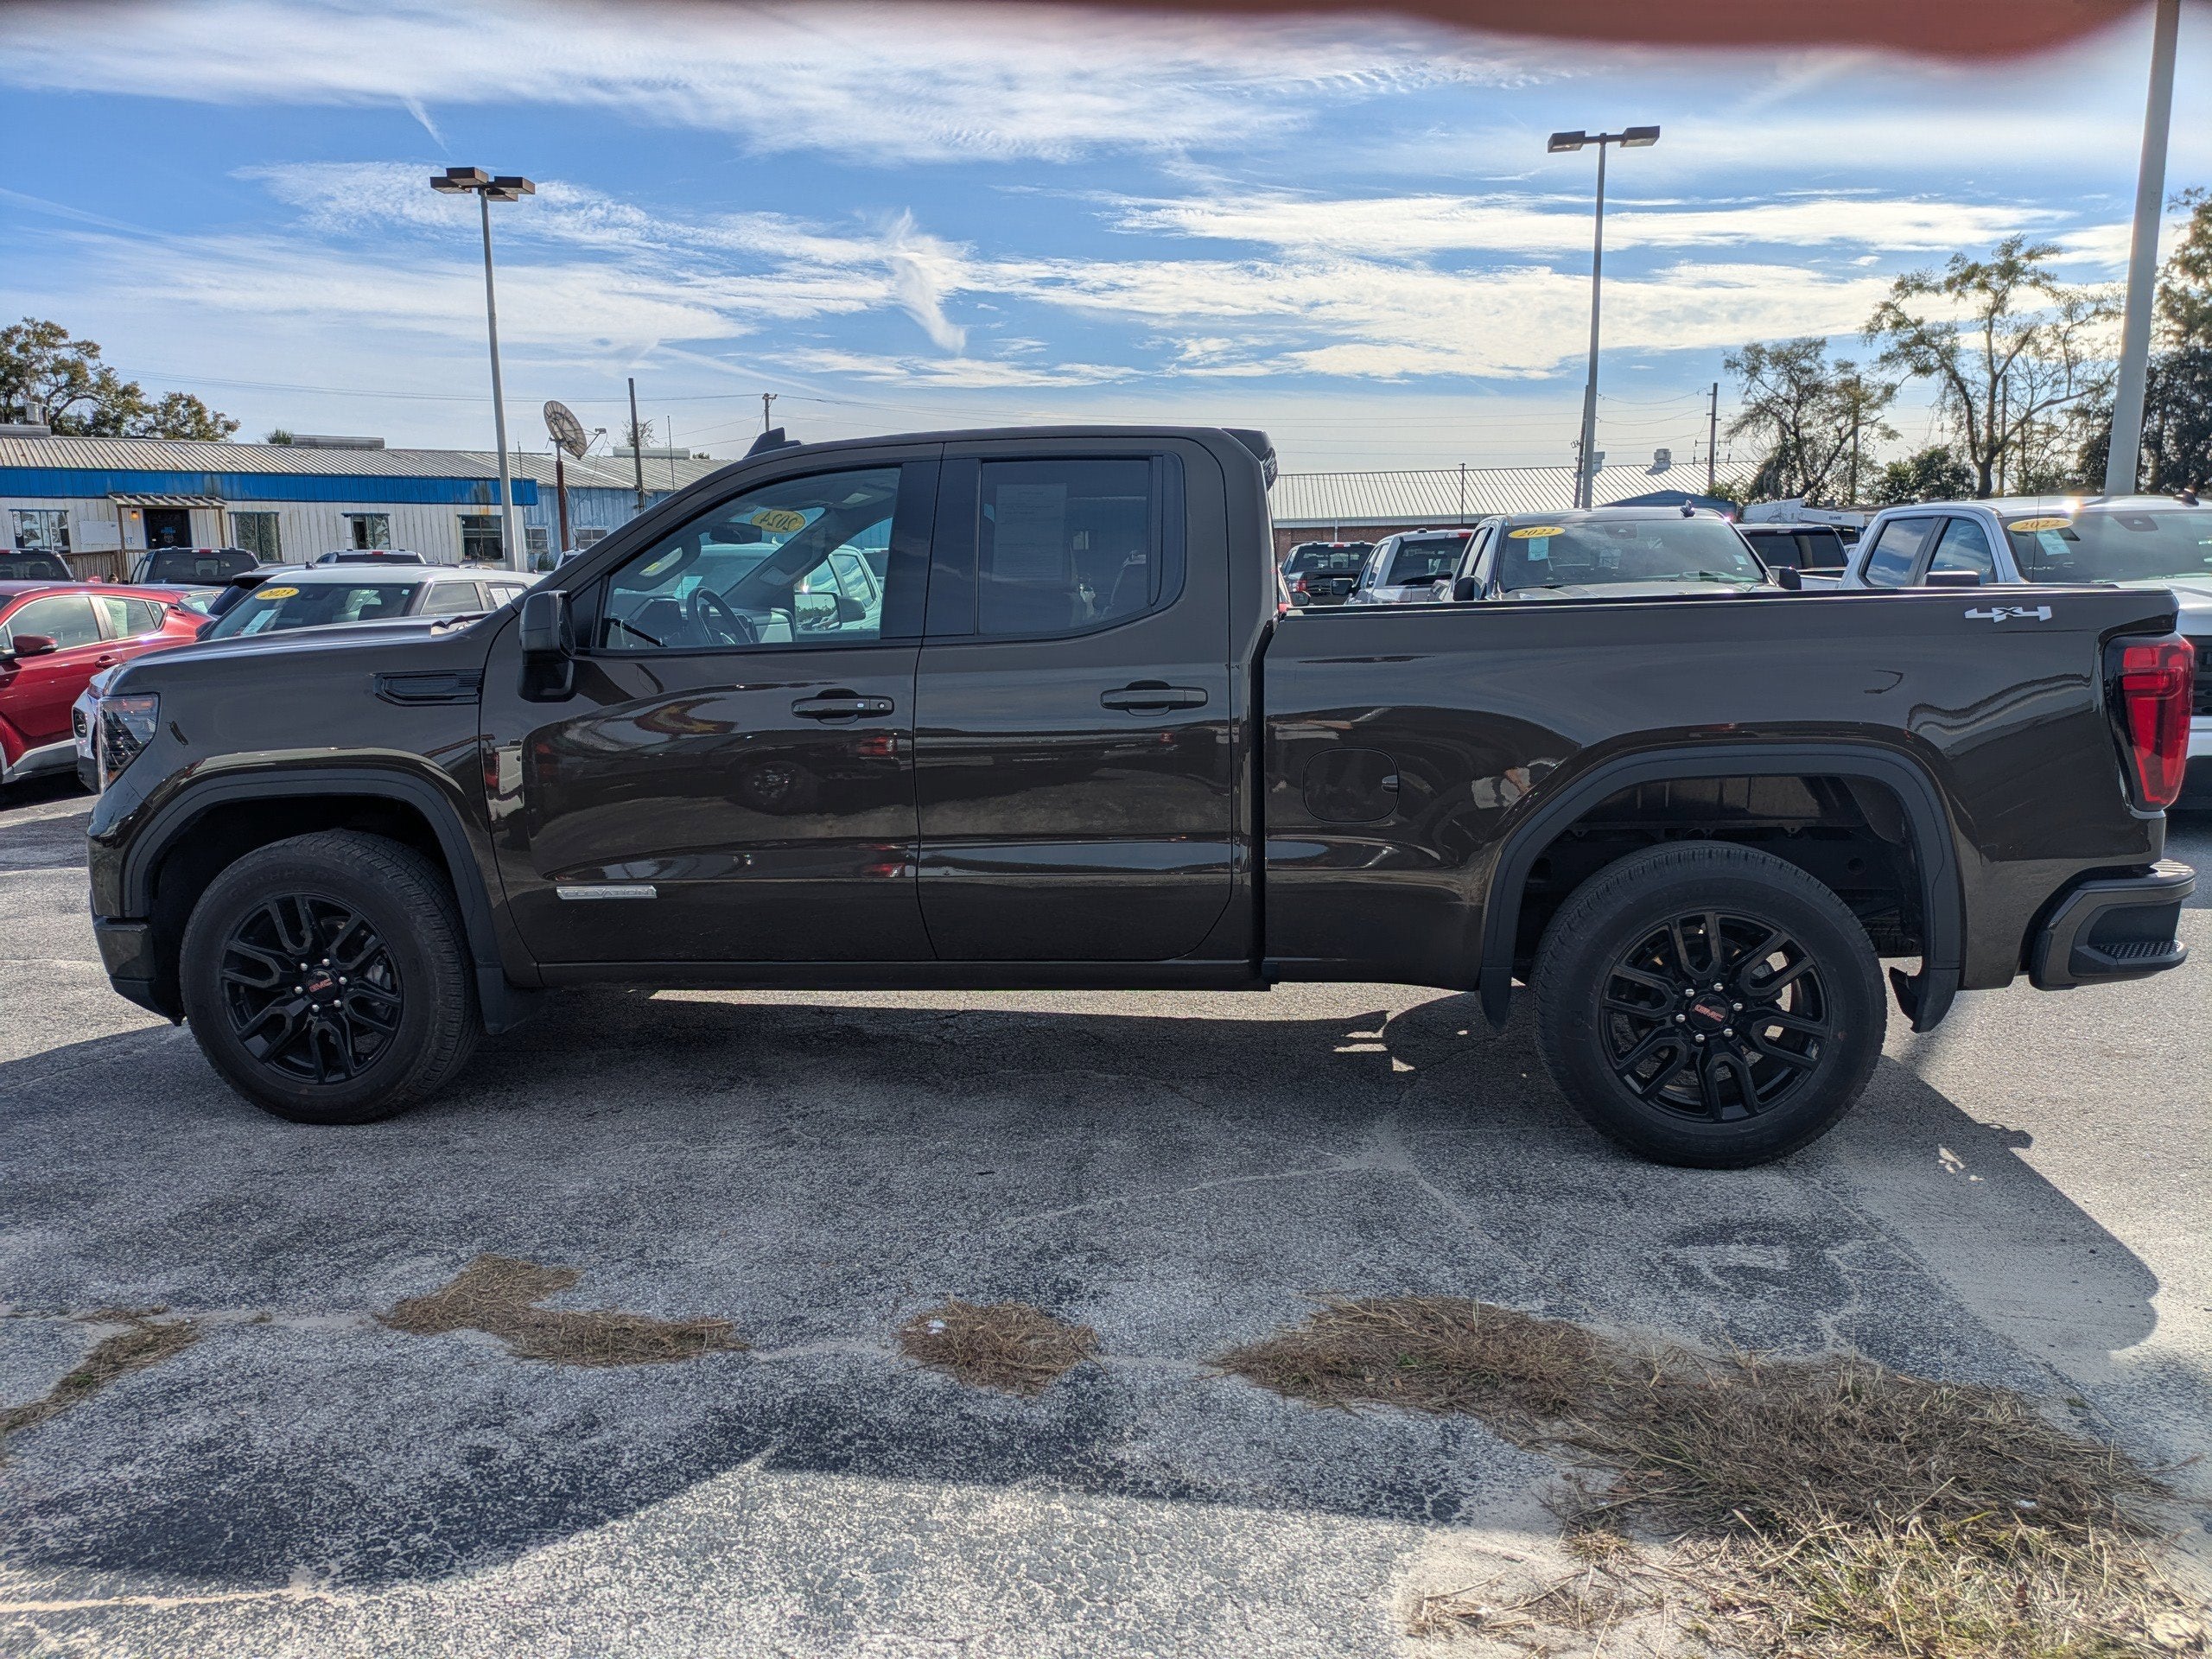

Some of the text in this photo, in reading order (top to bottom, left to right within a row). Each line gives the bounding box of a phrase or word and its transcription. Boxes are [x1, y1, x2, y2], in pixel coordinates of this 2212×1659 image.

[2020, 519, 2060, 530] 2022
[1517, 528, 1555, 537] 2022
[309, 978, 333, 992] GMC
[1694, 1004, 1724, 1021] GMC
